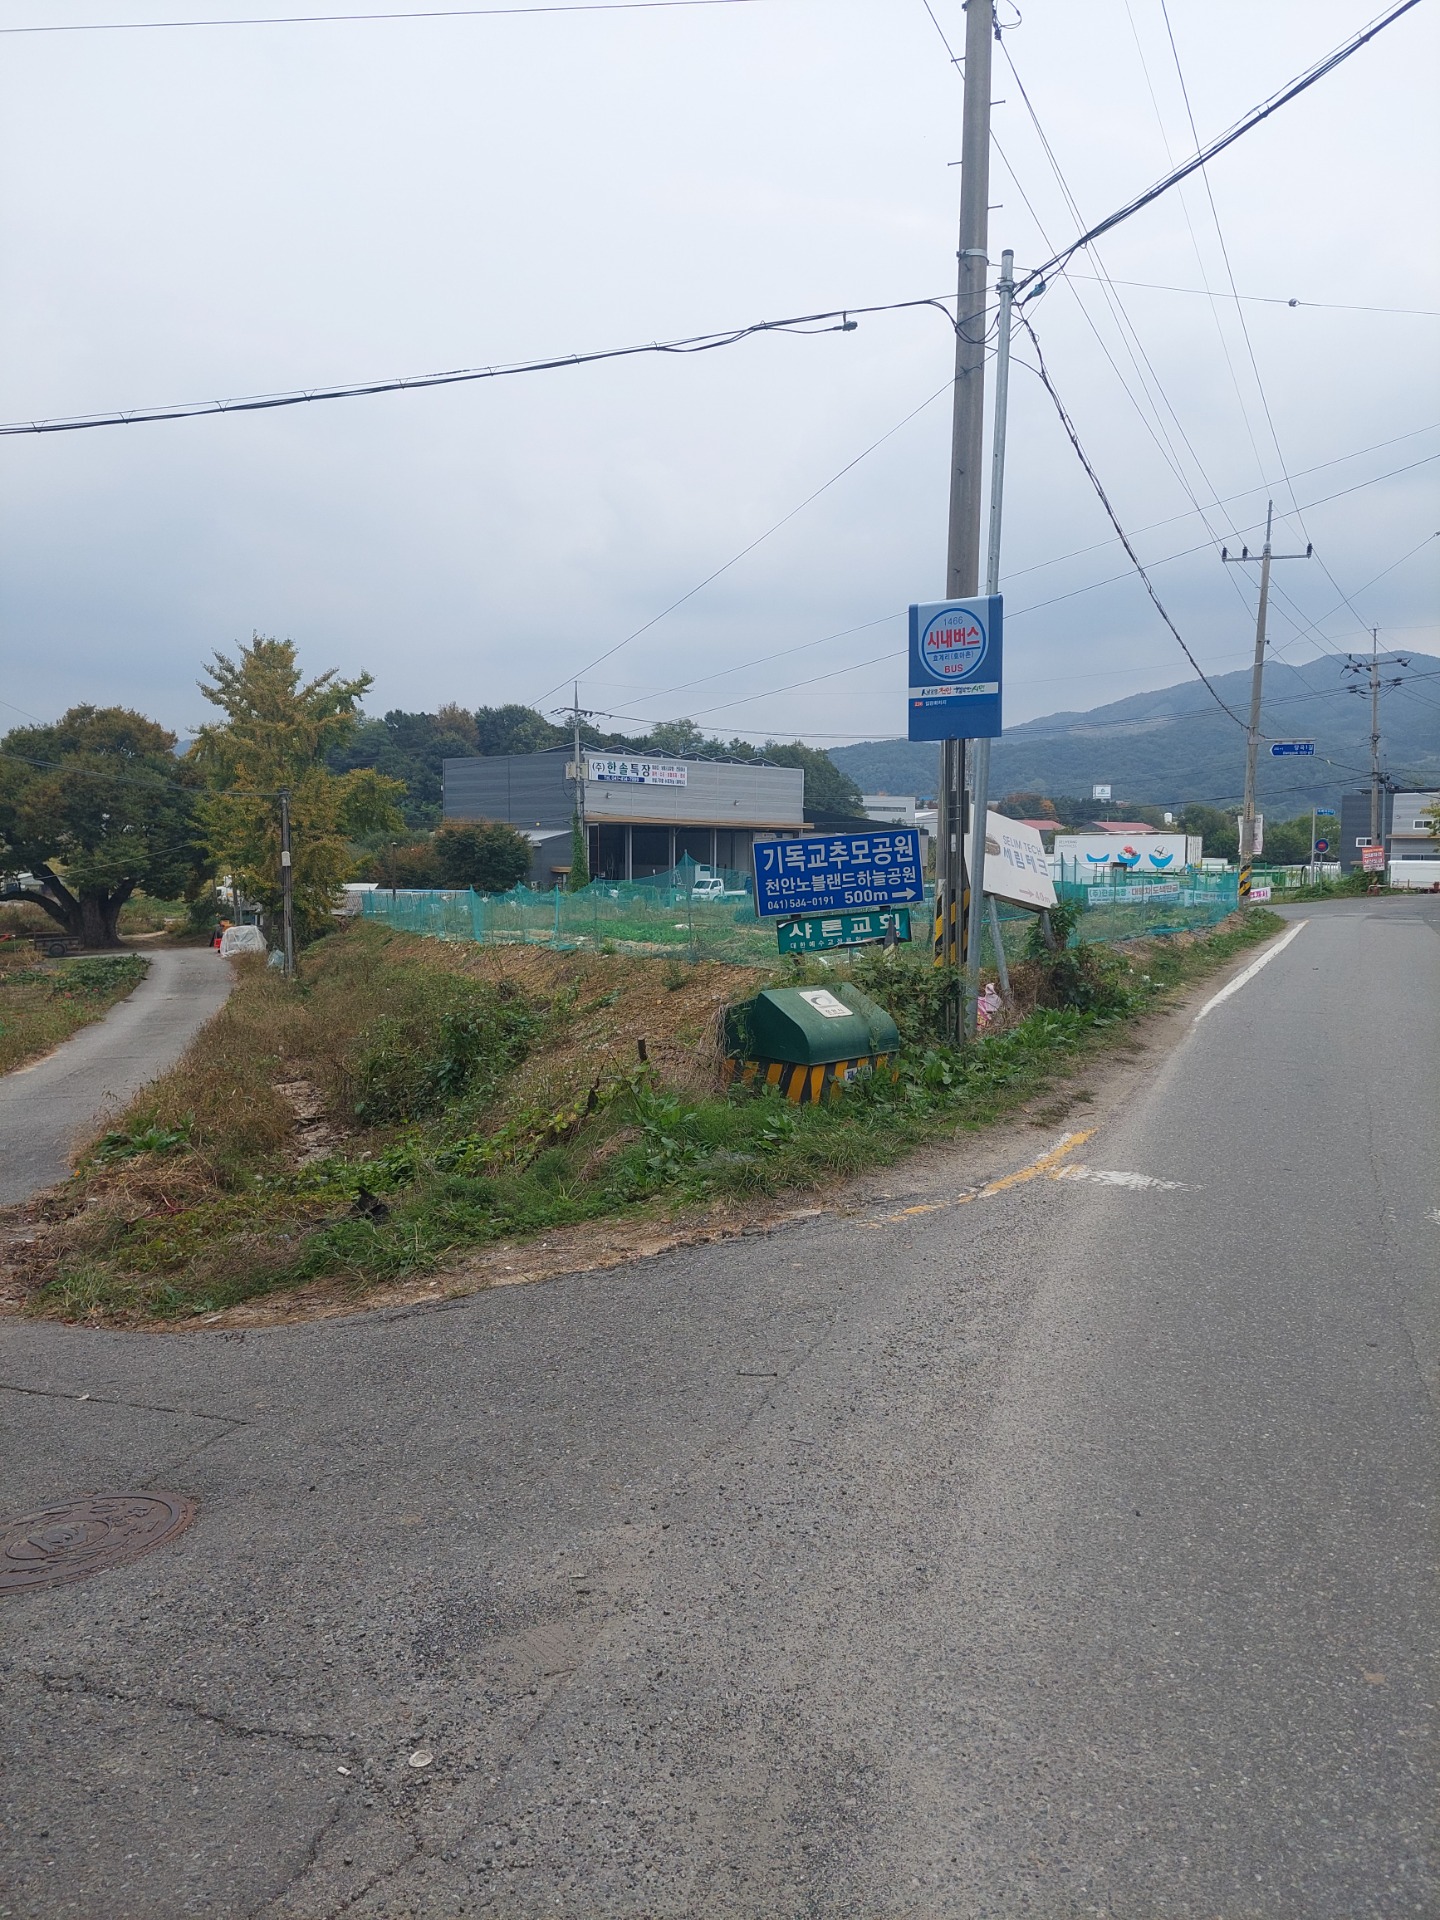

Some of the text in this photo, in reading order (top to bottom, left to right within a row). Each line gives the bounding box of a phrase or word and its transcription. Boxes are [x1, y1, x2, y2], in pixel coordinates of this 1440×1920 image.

[944, 616, 963, 626] 1466
[928, 626, 980, 649] 시내버스
[944, 664, 964, 674] BUS
[763, 834, 914, 874] 기독교추모공원
[1002, 835, 1042, 855] SELIM TECH
[1003, 846, 1049, 877] 세림테크
[765, 865, 916, 896] 천안노블랜드하늘공원
[844, 889, 889, 904] 500m
[788, 913, 900, 939] 샤론교회
